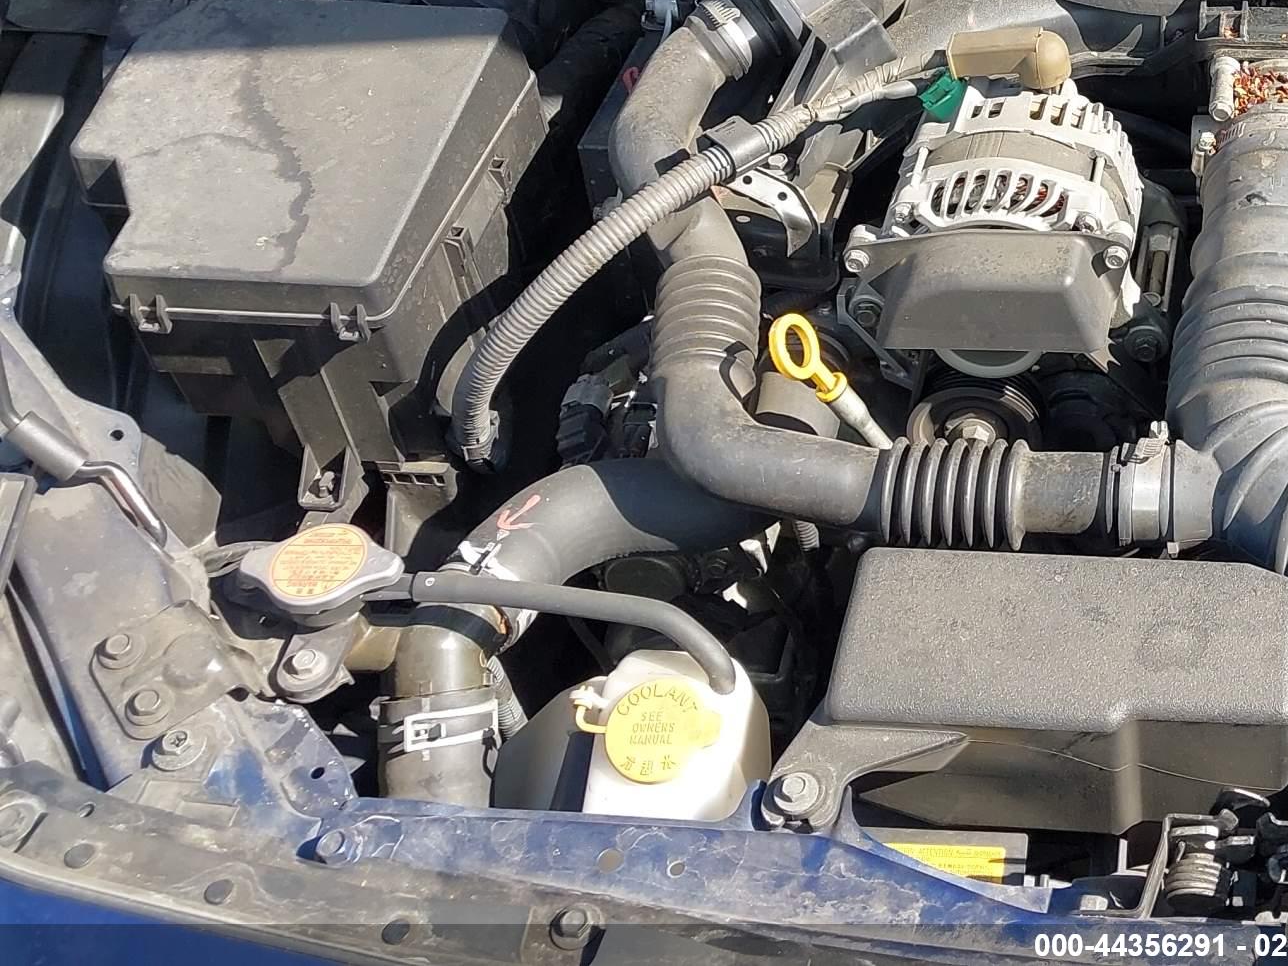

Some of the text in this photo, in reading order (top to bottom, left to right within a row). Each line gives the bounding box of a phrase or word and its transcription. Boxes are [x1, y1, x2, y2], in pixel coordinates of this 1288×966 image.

[616, 683, 698, 716] COOLANT
[640, 711, 664, 722] SEE
[629, 735, 674, 745] MANUAL
